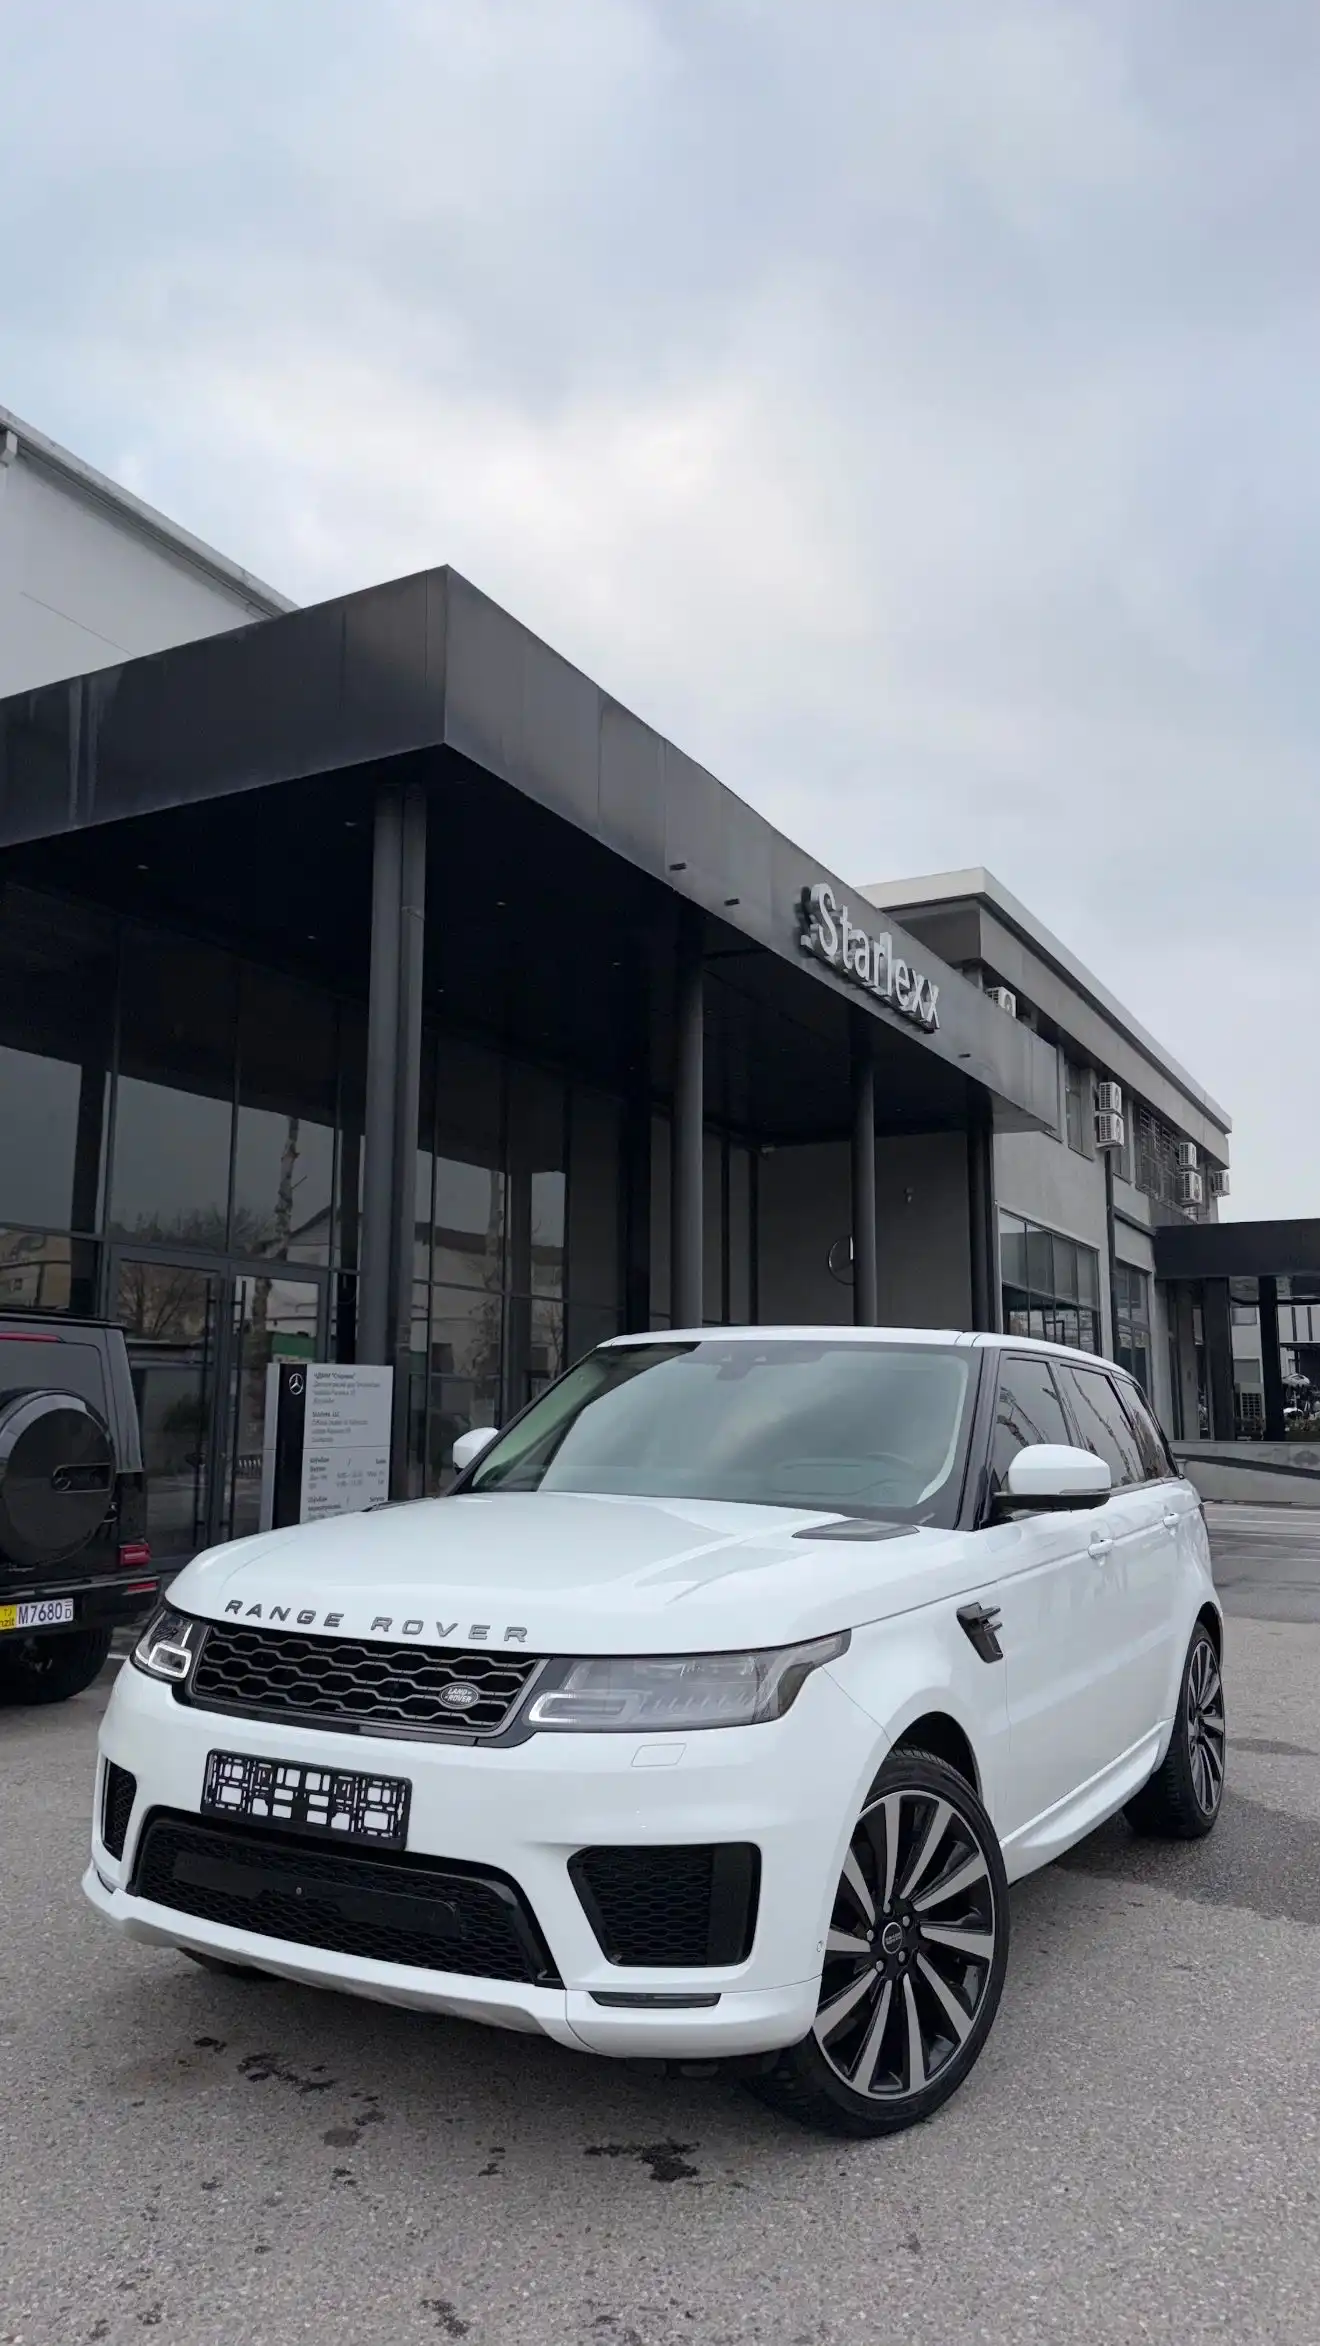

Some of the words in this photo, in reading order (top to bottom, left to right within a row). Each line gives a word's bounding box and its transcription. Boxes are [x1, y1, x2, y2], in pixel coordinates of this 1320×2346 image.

[810, 883, 940, 1030] Starlexx
[224, 1599, 344, 1628] RANGE
[370, 1616, 528, 1643] ROVER
[448, 1695, 472, 1703] ROVER
